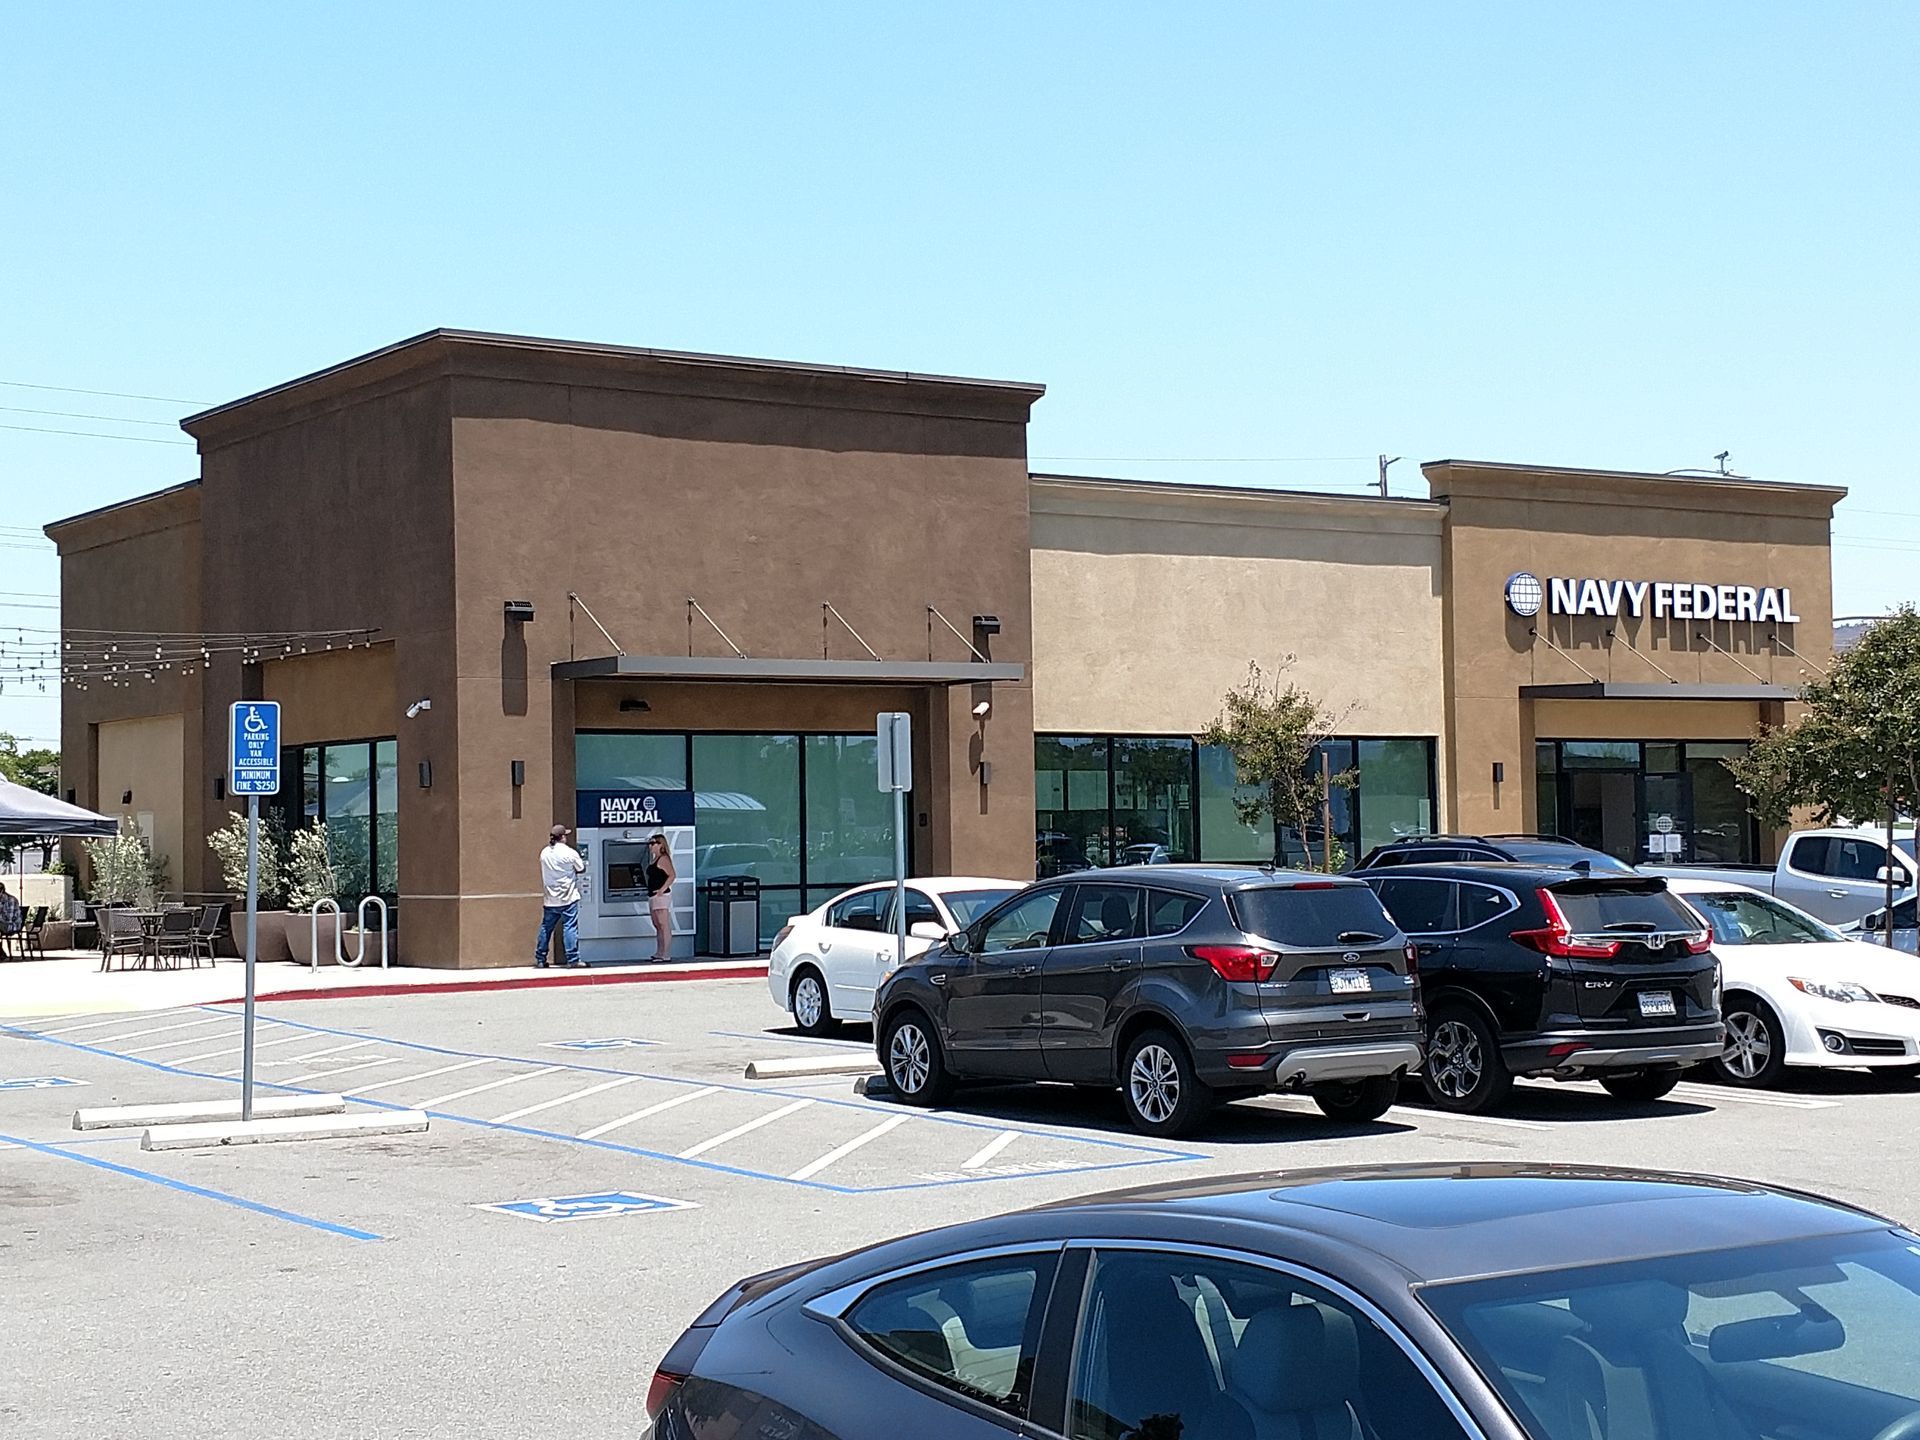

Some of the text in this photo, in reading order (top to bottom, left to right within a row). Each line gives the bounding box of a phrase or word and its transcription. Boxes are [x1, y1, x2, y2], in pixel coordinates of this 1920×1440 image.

[1548, 577, 1800, 623] NAVY FEDERAL
[243, 732, 270, 741] PARKING
[248, 741, 265, 749] ONLY
[238, 757, 274, 766] ACCESSIBLE
[241, 770, 271, 780] MINIMUM
[236, 780, 276, 791] FINE $250
[600, 798, 641, 810] NAVY
[600, 810, 662, 824] FEDERAL
[1584, 981, 1614, 989] CR-V
